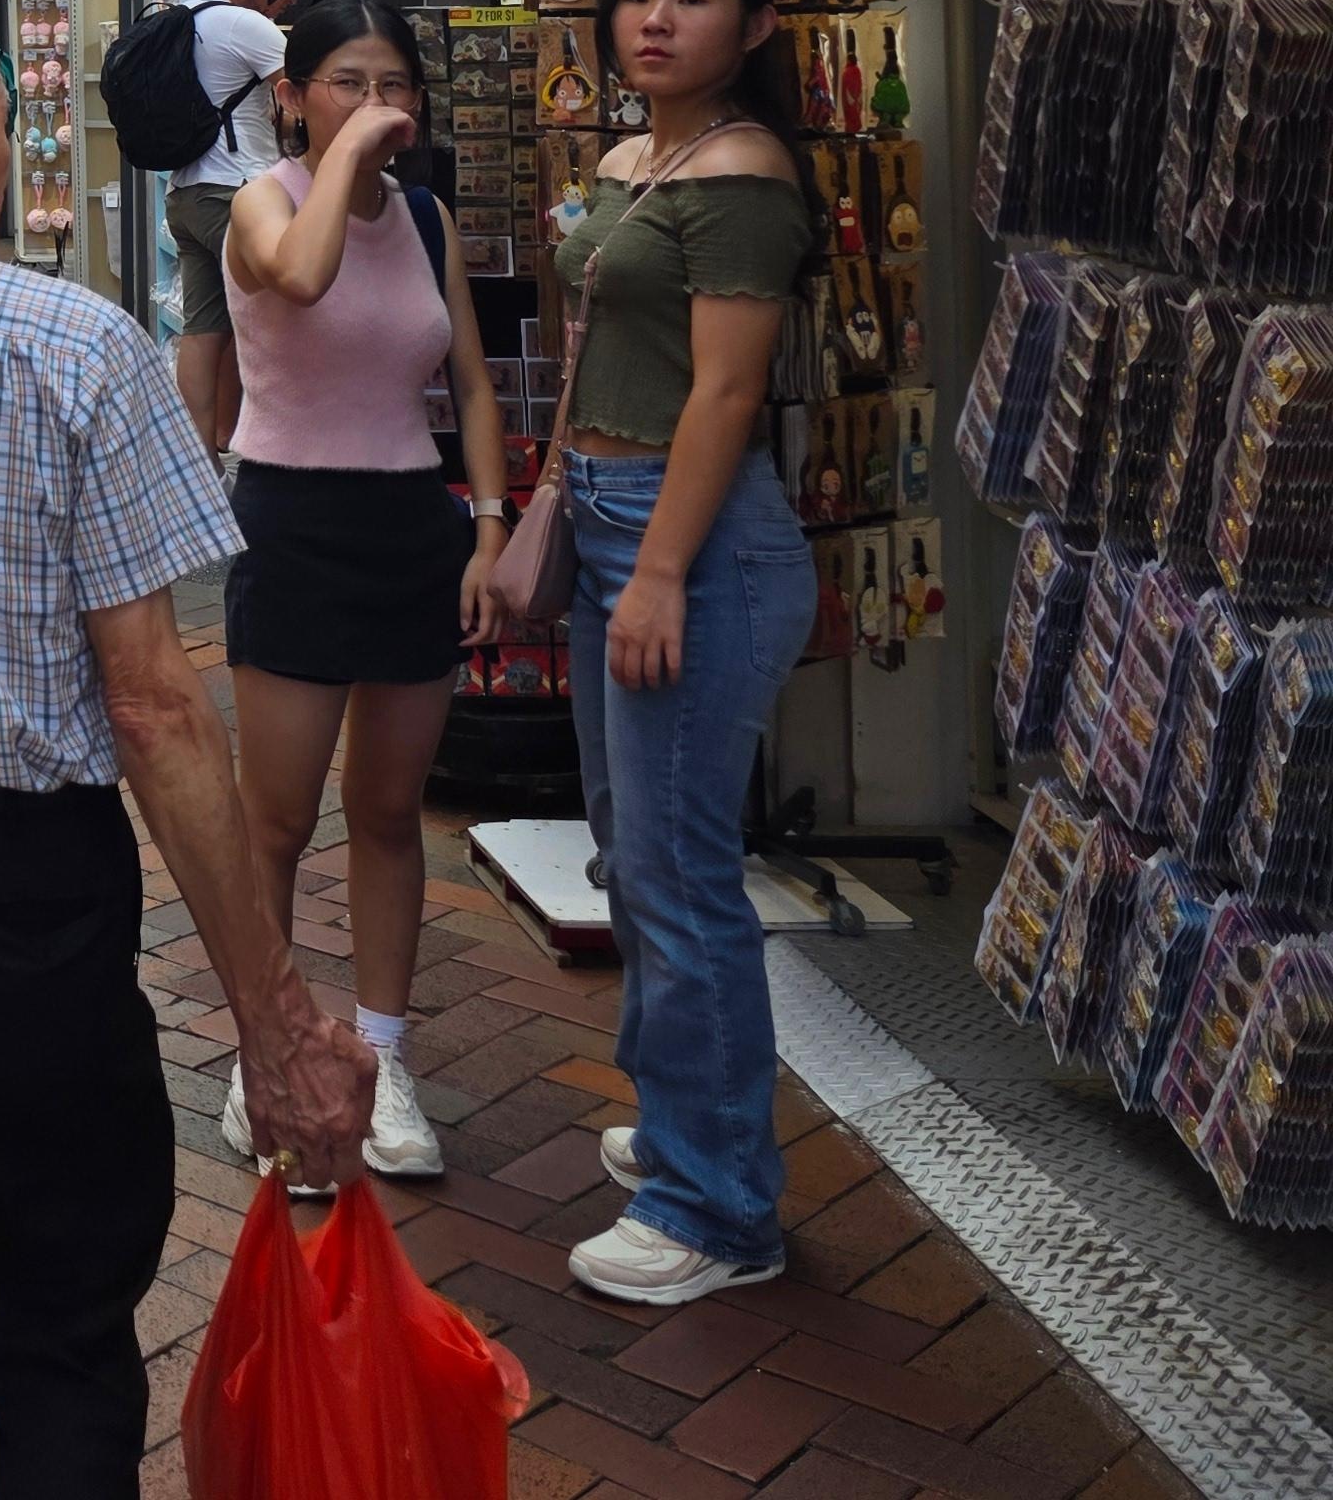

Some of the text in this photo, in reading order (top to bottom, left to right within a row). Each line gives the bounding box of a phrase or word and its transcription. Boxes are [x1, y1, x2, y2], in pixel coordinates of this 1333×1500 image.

[476, 11, 483, 23] 2
[485, 10, 503, 22] FOR
[505, 9, 515, 22] $1
